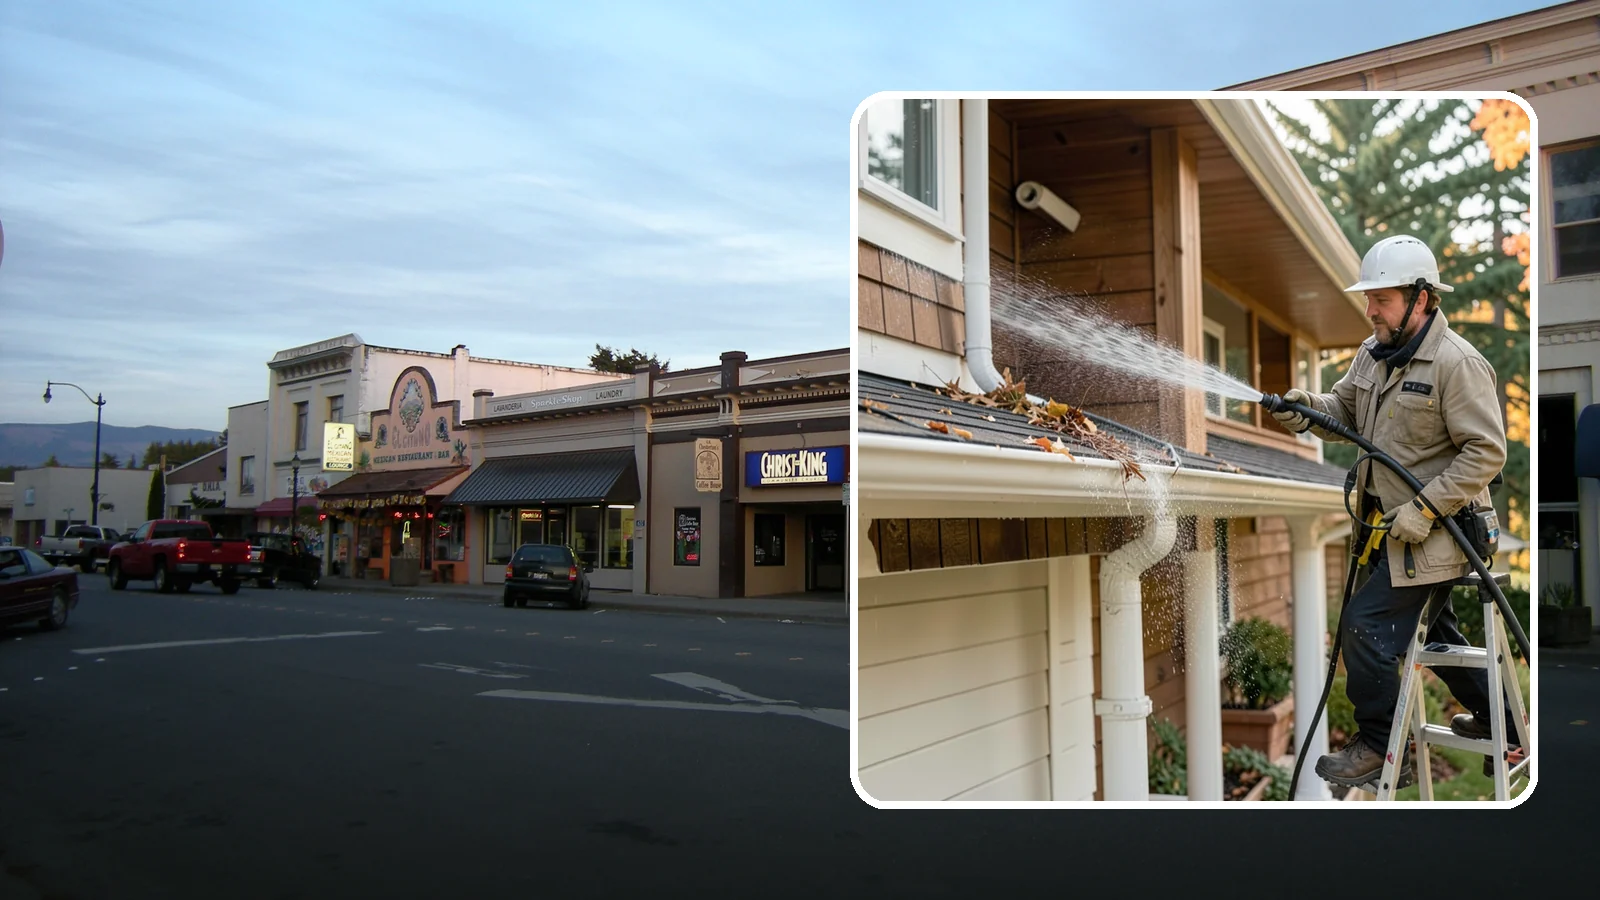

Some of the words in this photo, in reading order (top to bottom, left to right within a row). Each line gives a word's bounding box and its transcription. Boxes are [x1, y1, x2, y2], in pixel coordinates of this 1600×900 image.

[493, 402, 522, 413] LAVANDERIA
[595, 389, 623, 400] LAUNDRY
[373, 455, 396, 464] MEXICAN
[397, 451, 433, 462] RESTAURANT
[437, 450, 450, 459] BAR
[761, 452, 797, 478] CHRIST
[799, 450, 827, 476] KING
